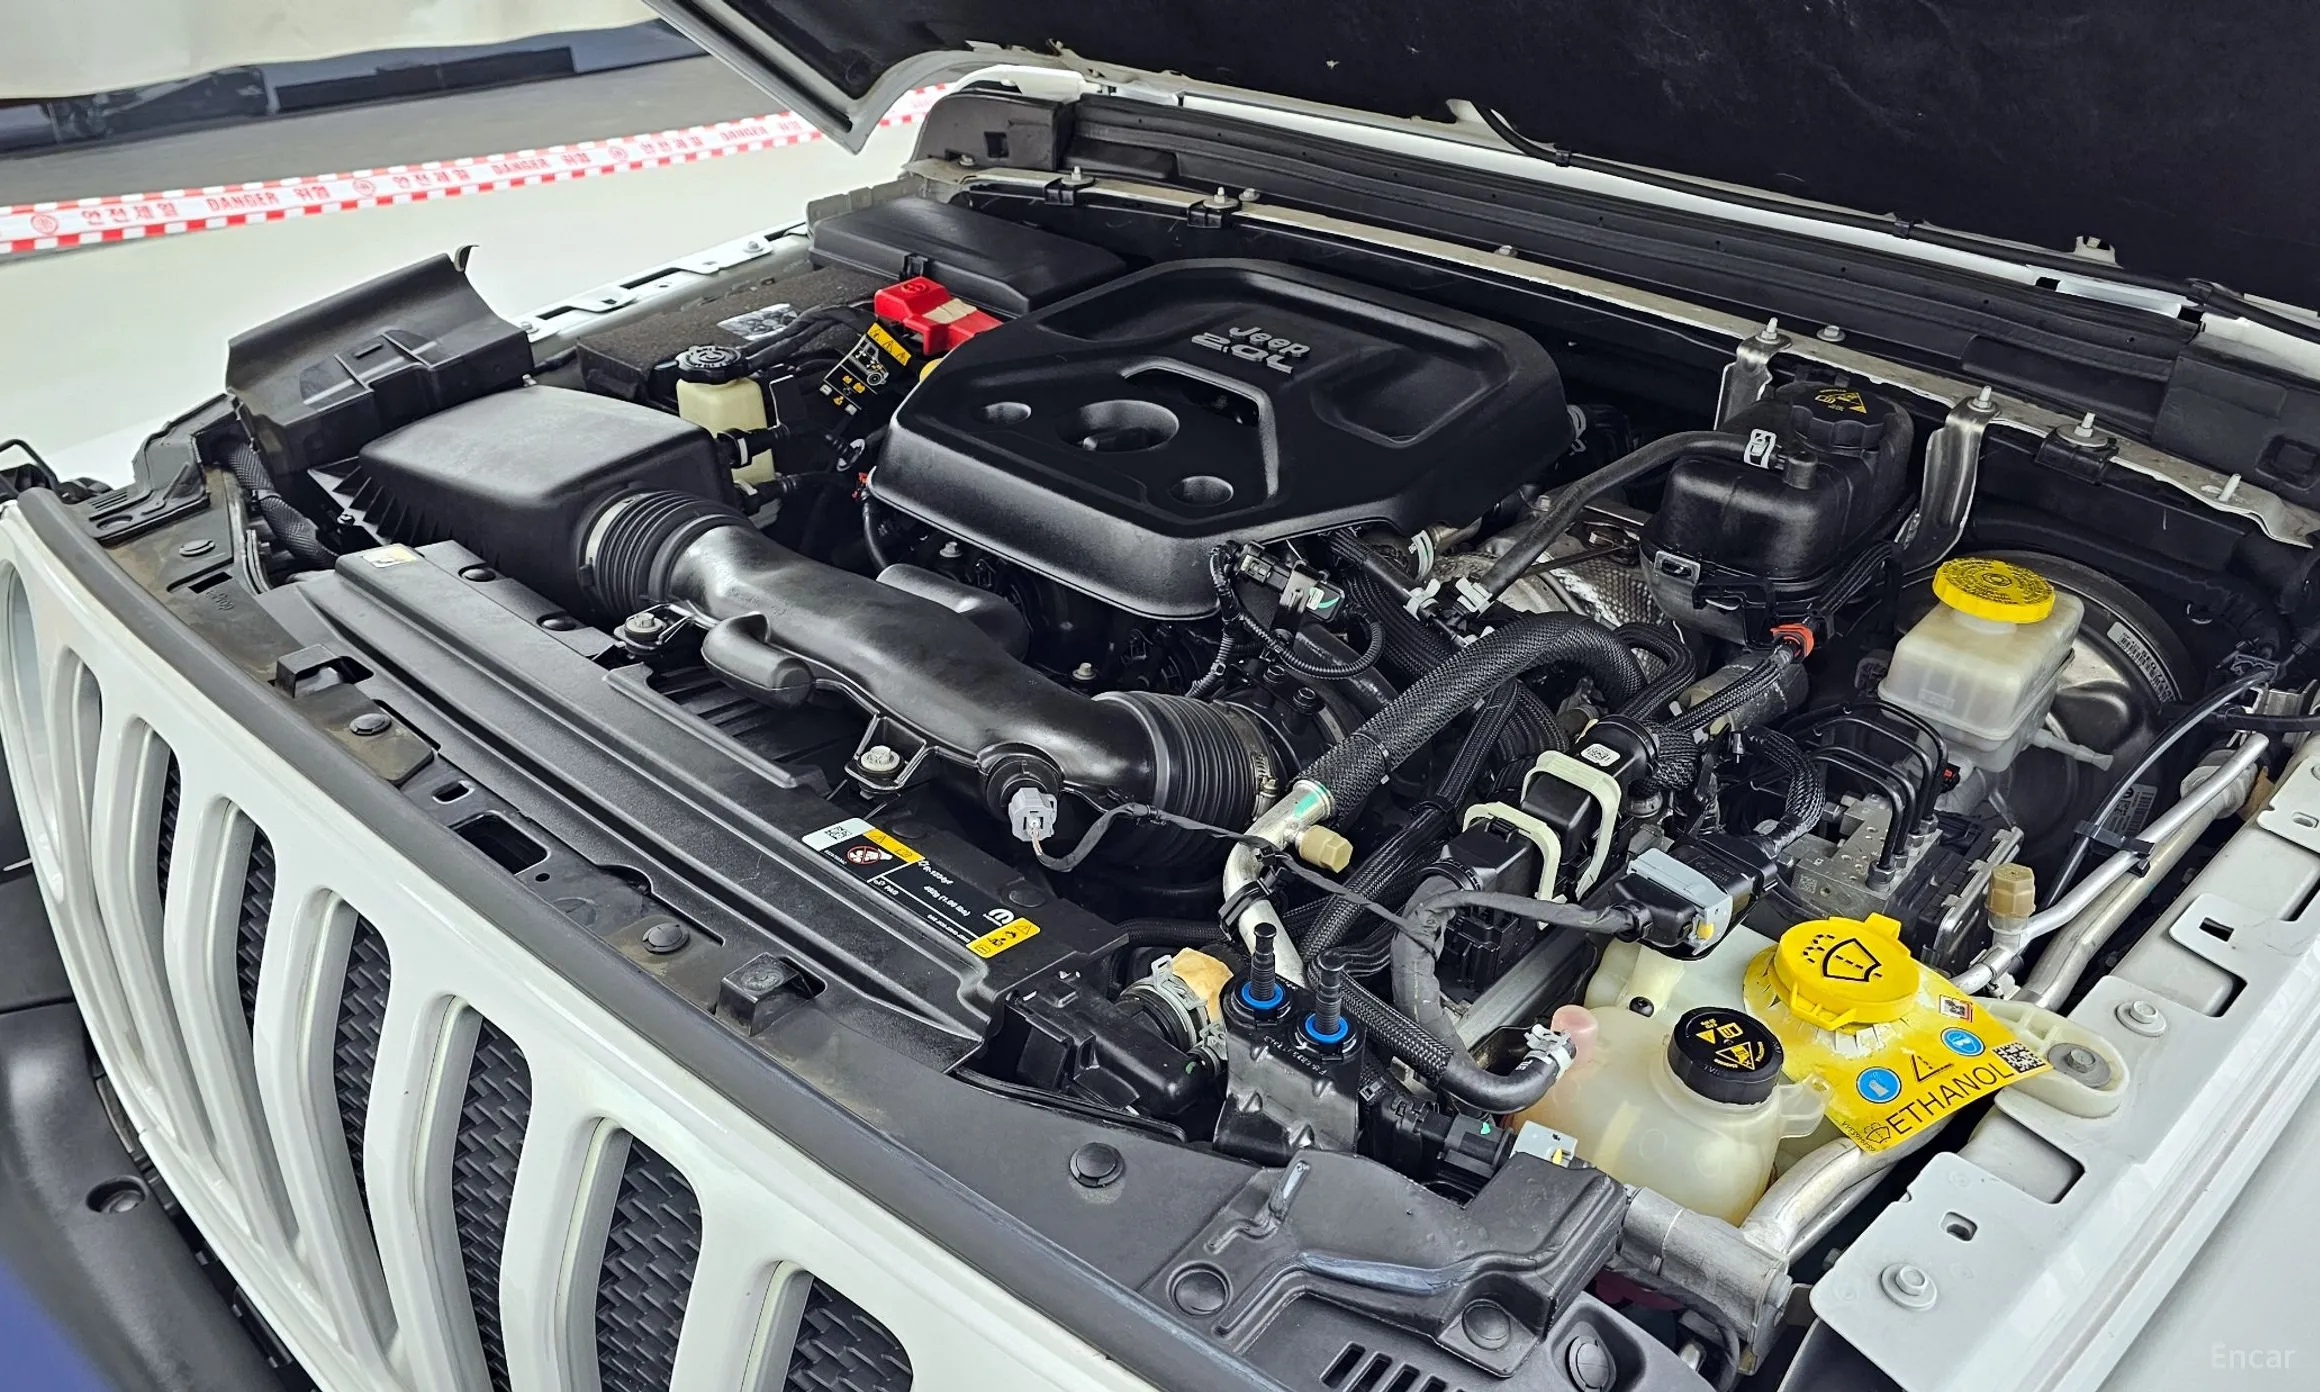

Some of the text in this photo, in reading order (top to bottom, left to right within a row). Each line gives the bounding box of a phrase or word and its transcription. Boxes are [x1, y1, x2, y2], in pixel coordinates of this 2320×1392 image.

[205, 191, 280, 213] DANGER
[491, 157, 551, 176] DANGER
[1191, 332, 1294, 374] 2.0L
[1229, 326, 1311, 358] Jeep
[1885, 1062, 2015, 1135] ETHANOL
